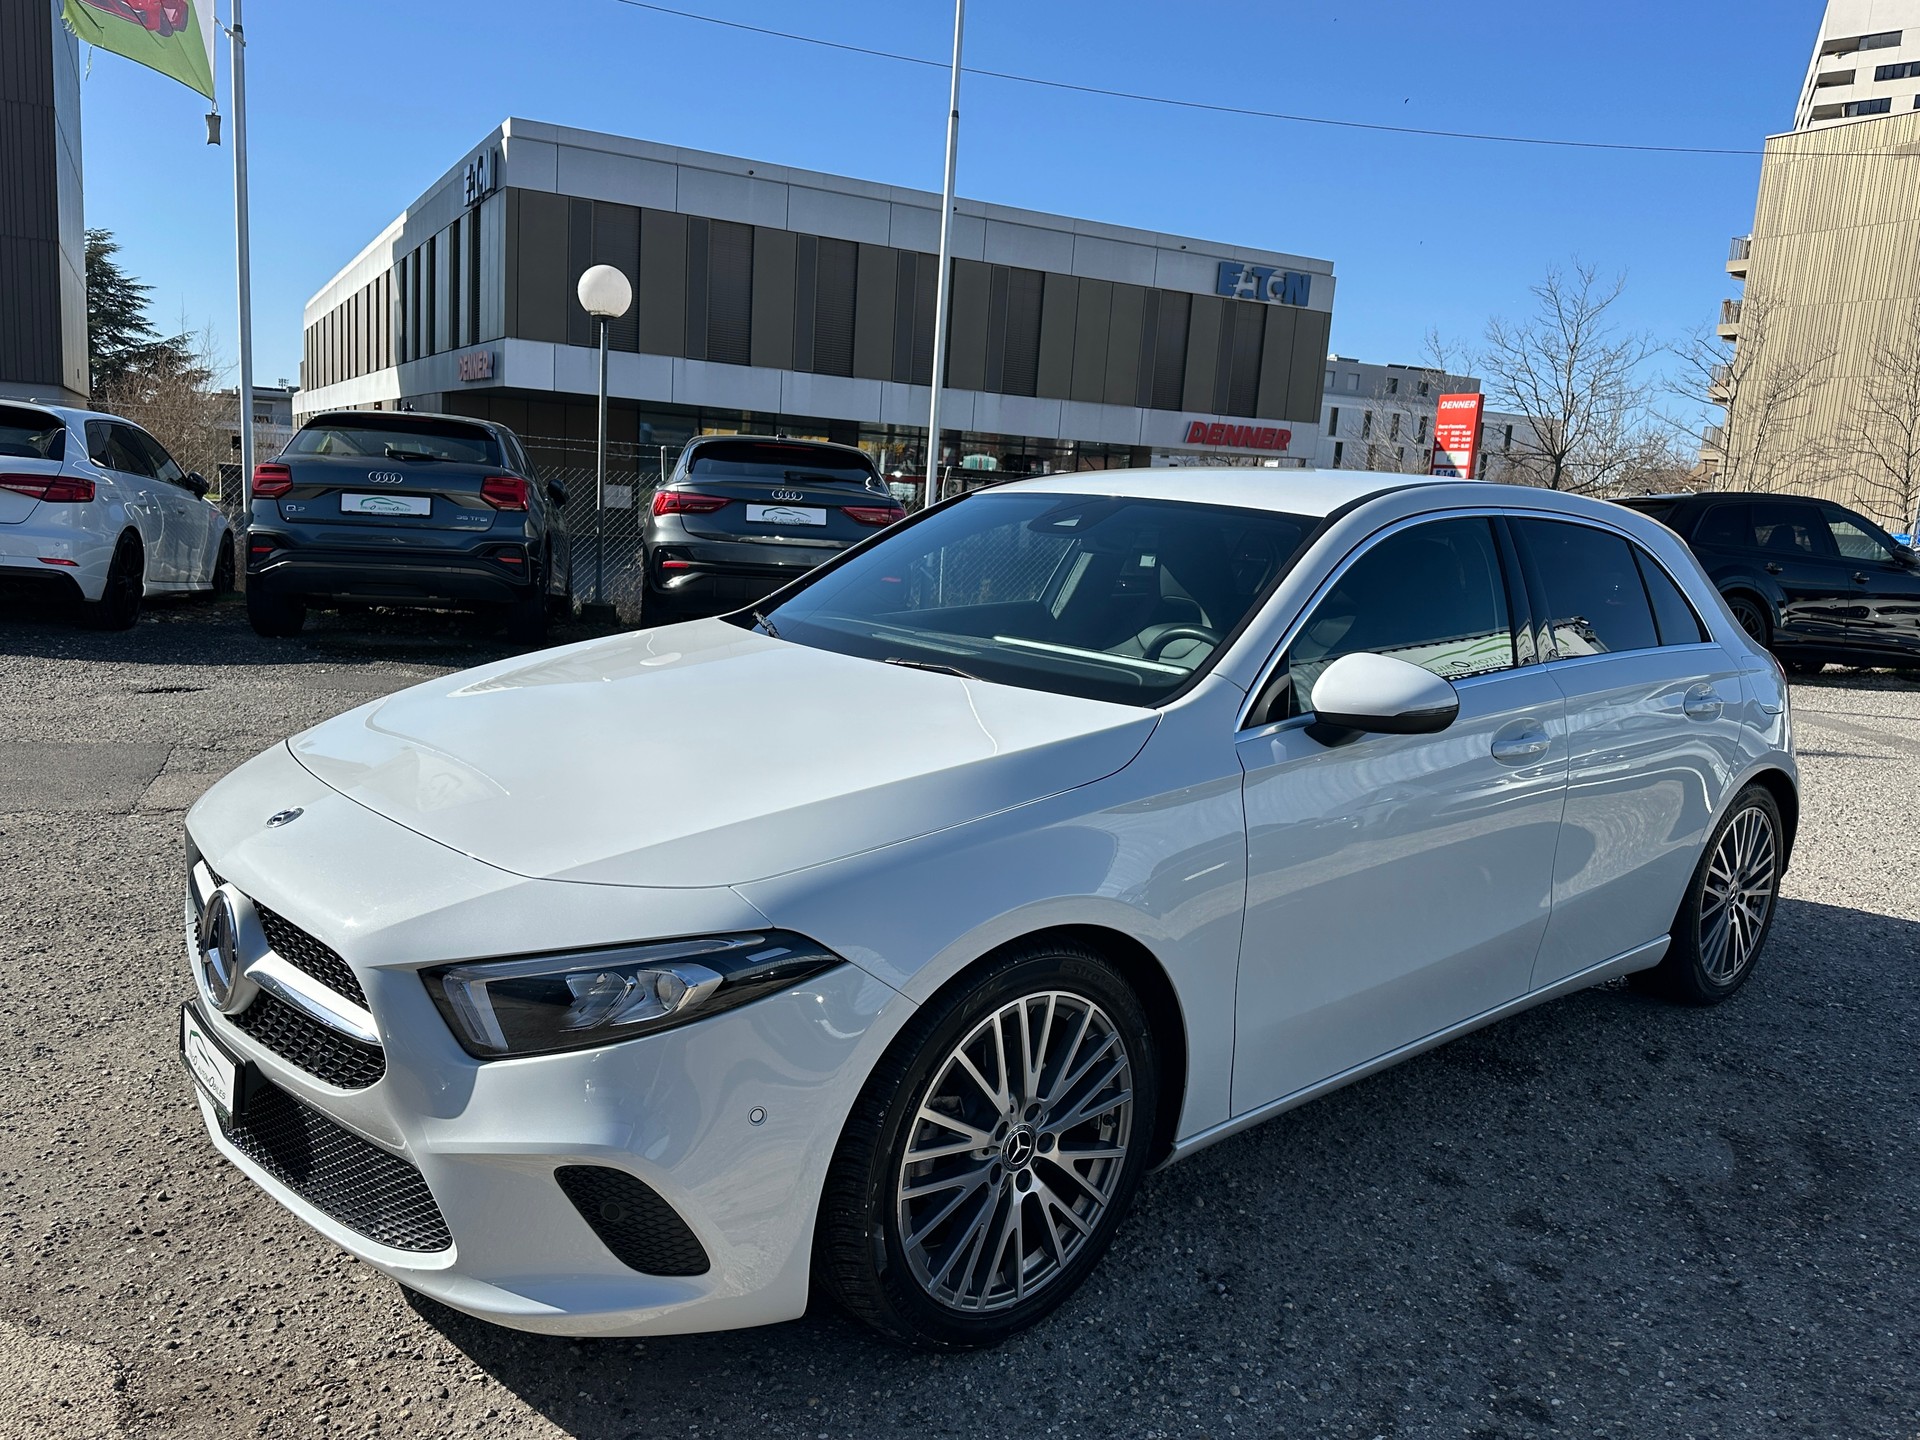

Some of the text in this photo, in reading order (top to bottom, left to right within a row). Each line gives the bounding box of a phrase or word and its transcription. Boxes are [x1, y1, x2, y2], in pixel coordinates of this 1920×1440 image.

[1216, 261, 1312, 307] EATON
[1440, 401, 1475, 409] DENNER
[1184, 421, 1292, 451] DENNER
